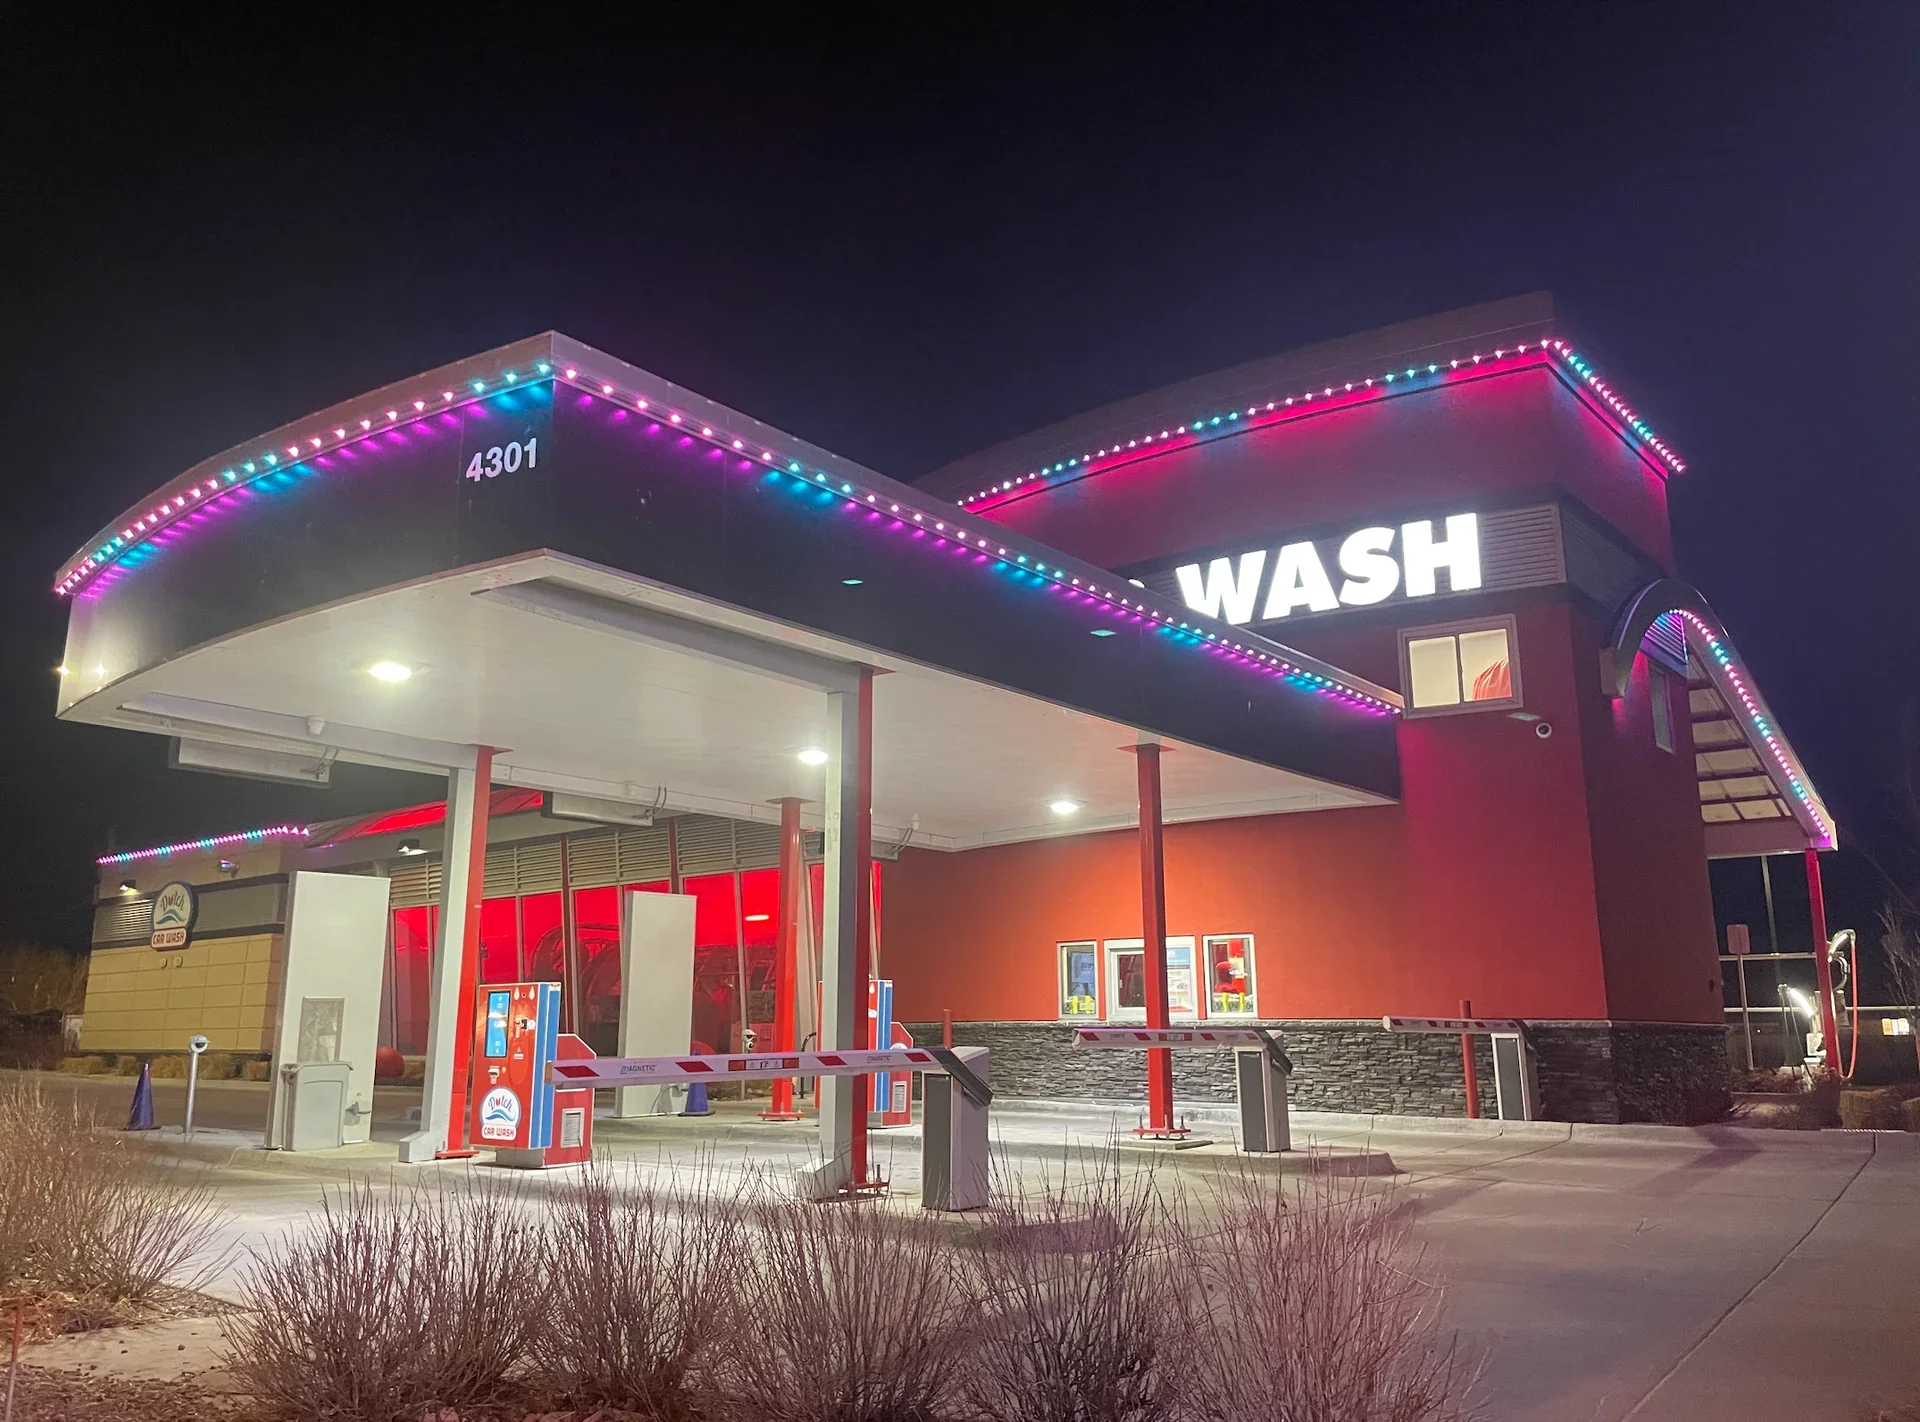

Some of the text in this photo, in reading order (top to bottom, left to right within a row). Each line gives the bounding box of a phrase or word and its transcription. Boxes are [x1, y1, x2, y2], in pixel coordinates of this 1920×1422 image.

[466, 437, 537, 482] 4301
[1175, 513, 1482, 624] WASH
[161, 890, 185, 912] Dutch
[153, 931, 184, 945] CAR WASH
[488, 1095, 513, 1111] Dutch
[483, 1127, 514, 1137] CAR WASH
